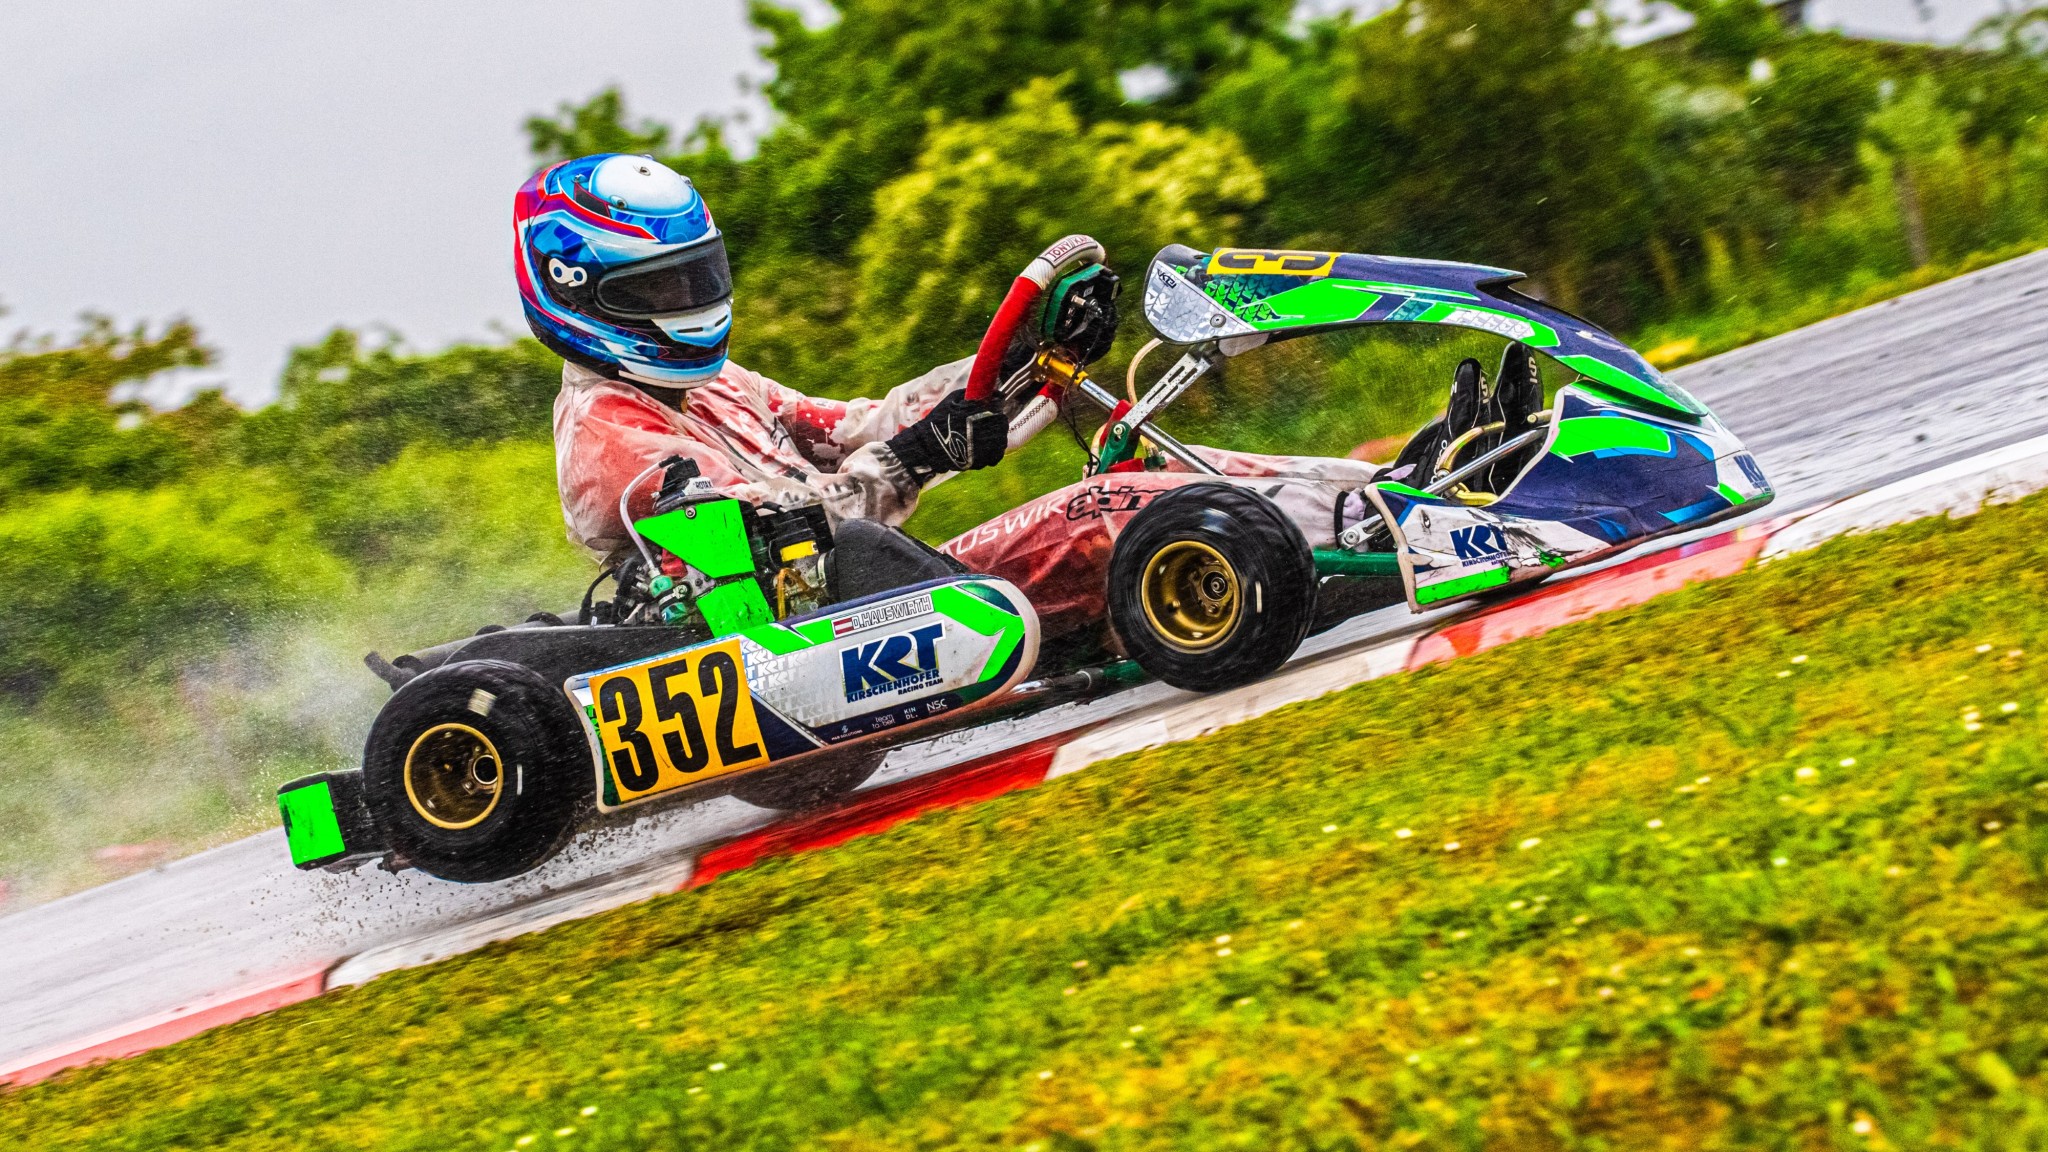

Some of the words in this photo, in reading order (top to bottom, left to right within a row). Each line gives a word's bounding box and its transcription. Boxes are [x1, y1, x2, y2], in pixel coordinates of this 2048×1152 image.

[694, 480, 713, 489] ROTAX
[1449, 522, 1508, 560] KRT
[852, 595, 933, 629] D.HAUSWIRTH
[841, 623, 944, 696] KRT
[846, 668, 940, 703] KIRSCHENHOFER
[897, 683, 925, 695] RACING
[925, 677, 944, 688] TEAM
[599, 650, 762, 793] 352
[903, 706, 916, 715] KIN
[926, 698, 947, 712] NSC
